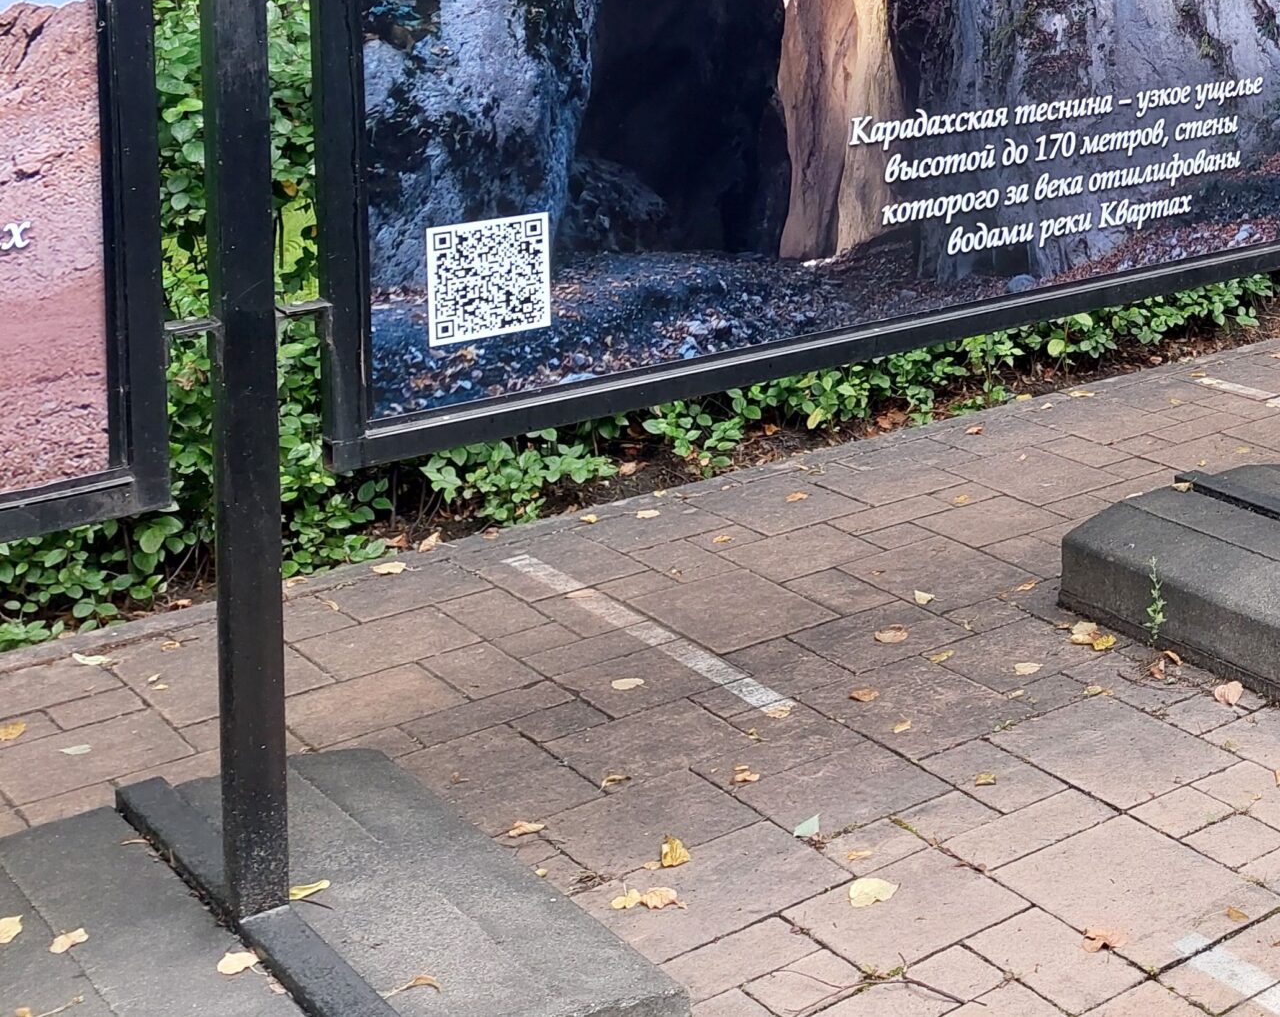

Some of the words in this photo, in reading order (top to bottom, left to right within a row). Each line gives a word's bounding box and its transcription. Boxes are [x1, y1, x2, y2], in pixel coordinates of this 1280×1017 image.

[848, 108, 1008, 151] Карадахская
[1014, 94, 1113, 125] теснина
[1136, 84, 1191, 118] узкое
[1195, 76, 1264, 110] ущелье
[884, 144, 996, 183] высотой
[1002, 138, 1029, 167] до
[1034, 131, 1076, 162] 170
[1079, 118, 1169, 157] метров,
[1175, 114, 1239, 142] стены
[881, 188, 1000, 225] которого
[1004, 183, 1029, 206] за
[1034, 172, 1083, 202] века
[1088, 148, 1241, 187] отшлифованы
[946, 222, 1035, 256] водами
[1039, 213, 1092, 248] реки
[1098, 194, 1193, 230] Квартах
